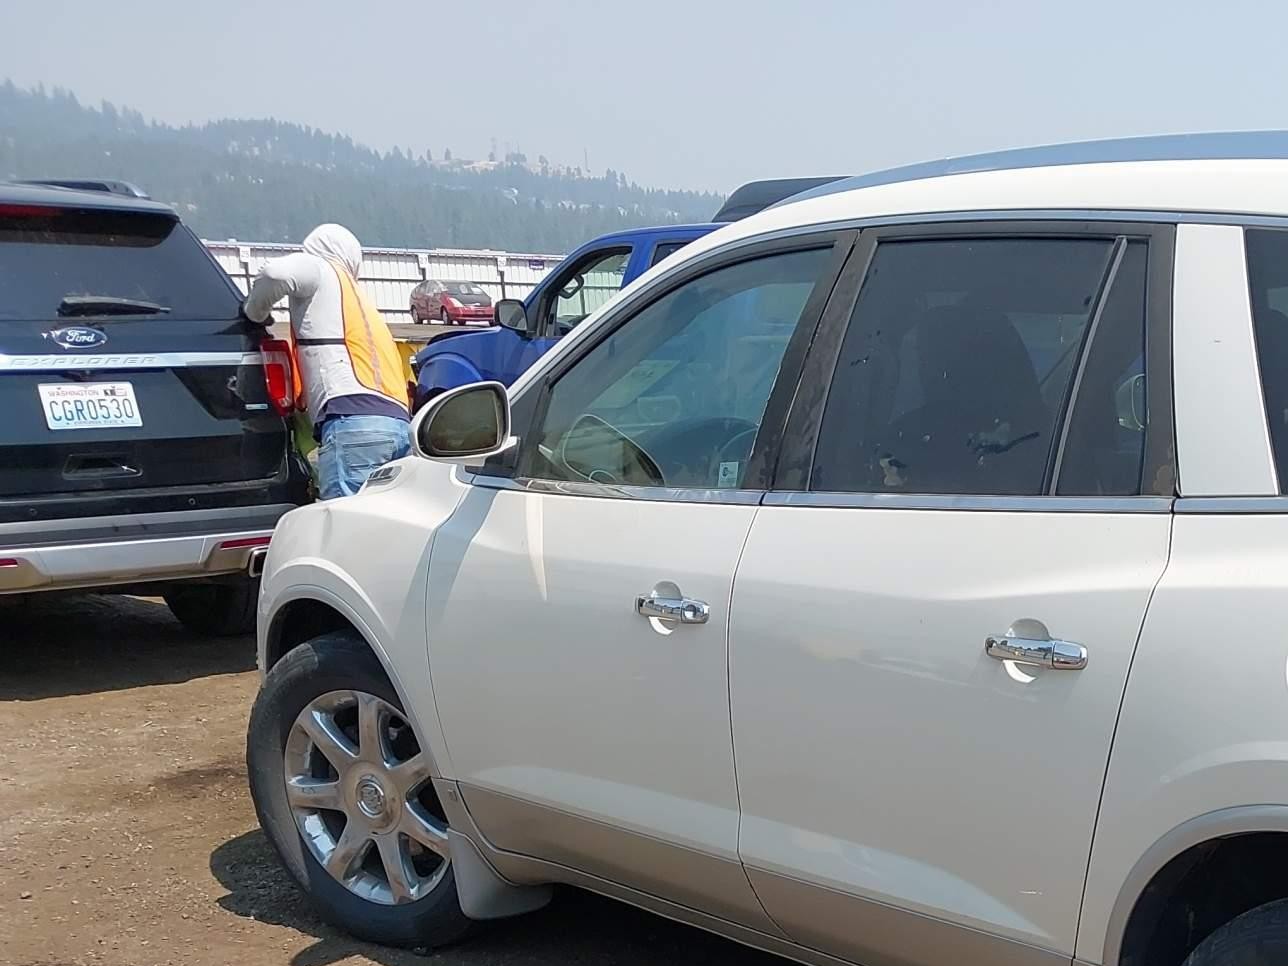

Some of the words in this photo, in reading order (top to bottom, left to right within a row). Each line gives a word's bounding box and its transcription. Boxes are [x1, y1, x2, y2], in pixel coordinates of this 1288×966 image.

[65, 330, 96, 343] Ford
[10, 356, 157, 368] EXPLORER
[48, 389, 99, 397] WASHINGTON
[49, 398, 135, 421] CGR0530
